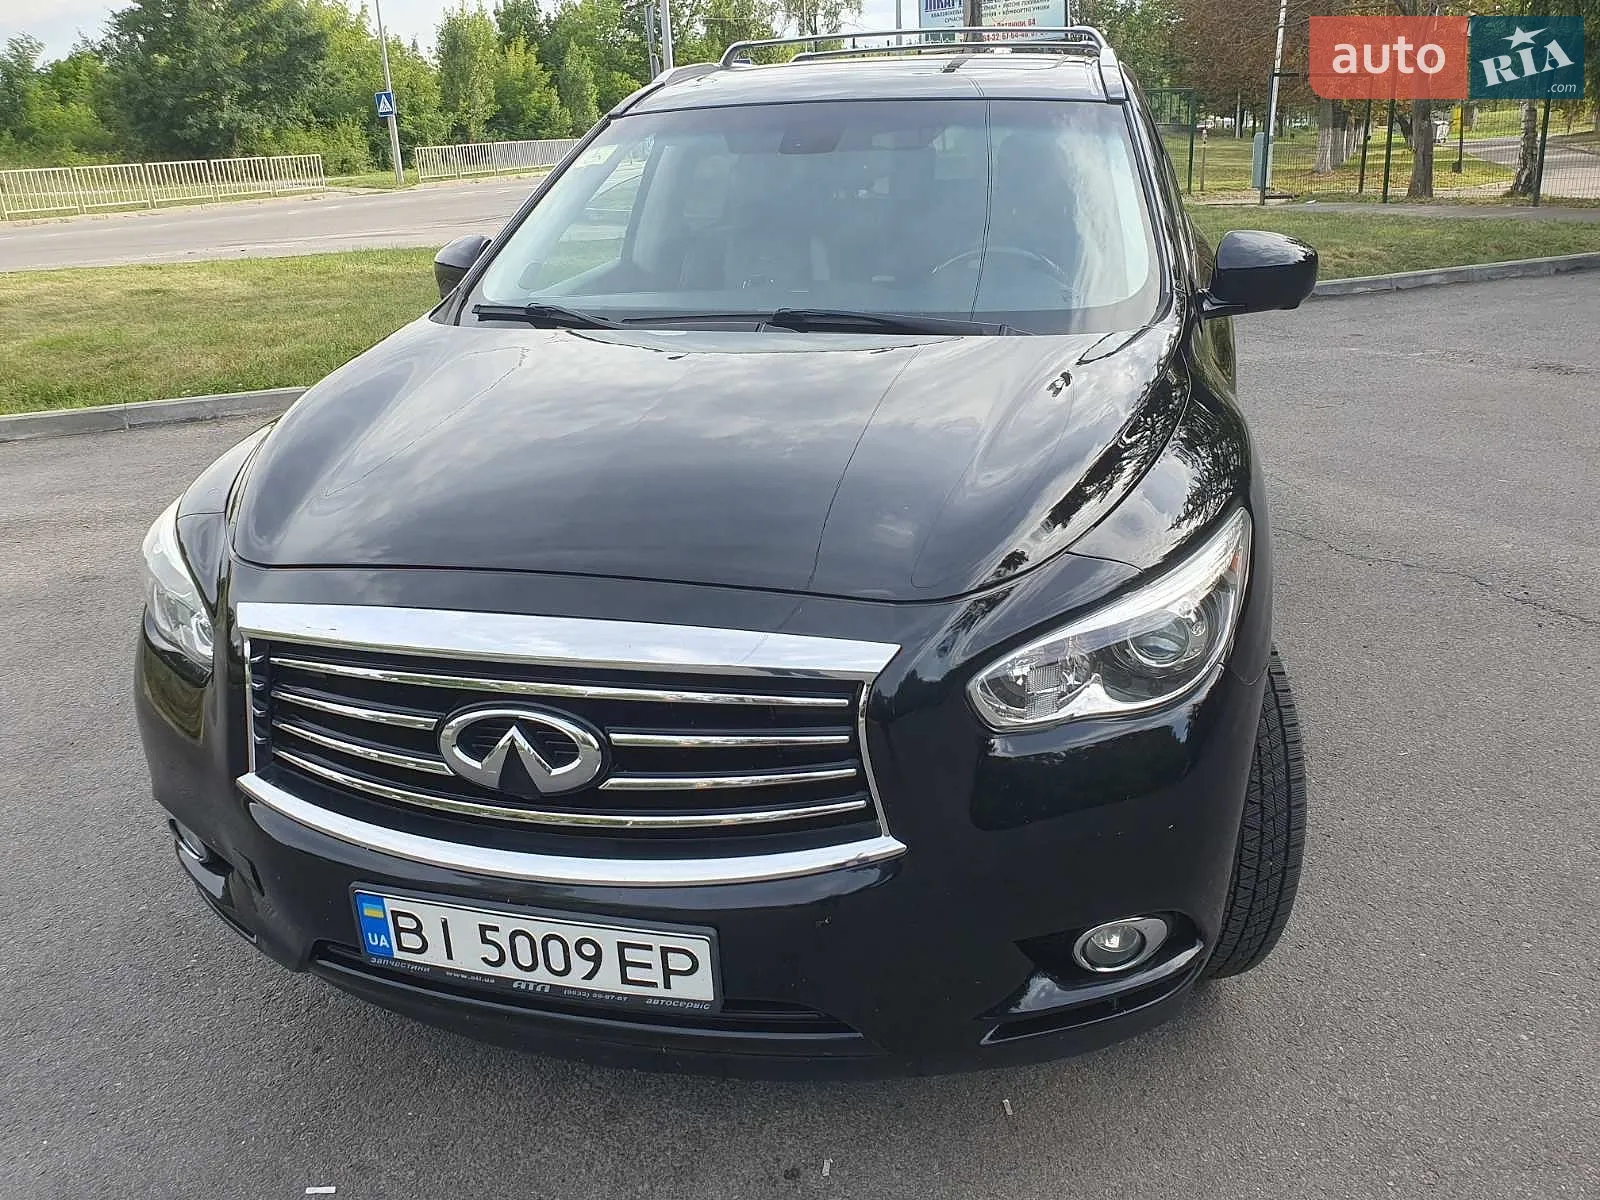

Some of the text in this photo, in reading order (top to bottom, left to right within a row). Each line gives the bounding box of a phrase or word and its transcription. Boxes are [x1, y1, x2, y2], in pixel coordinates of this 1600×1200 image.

[367, 932, 391, 949] UA
[389, 909, 700, 990] BI 5009 EP
[645, 998, 712, 1010] автосервіс
